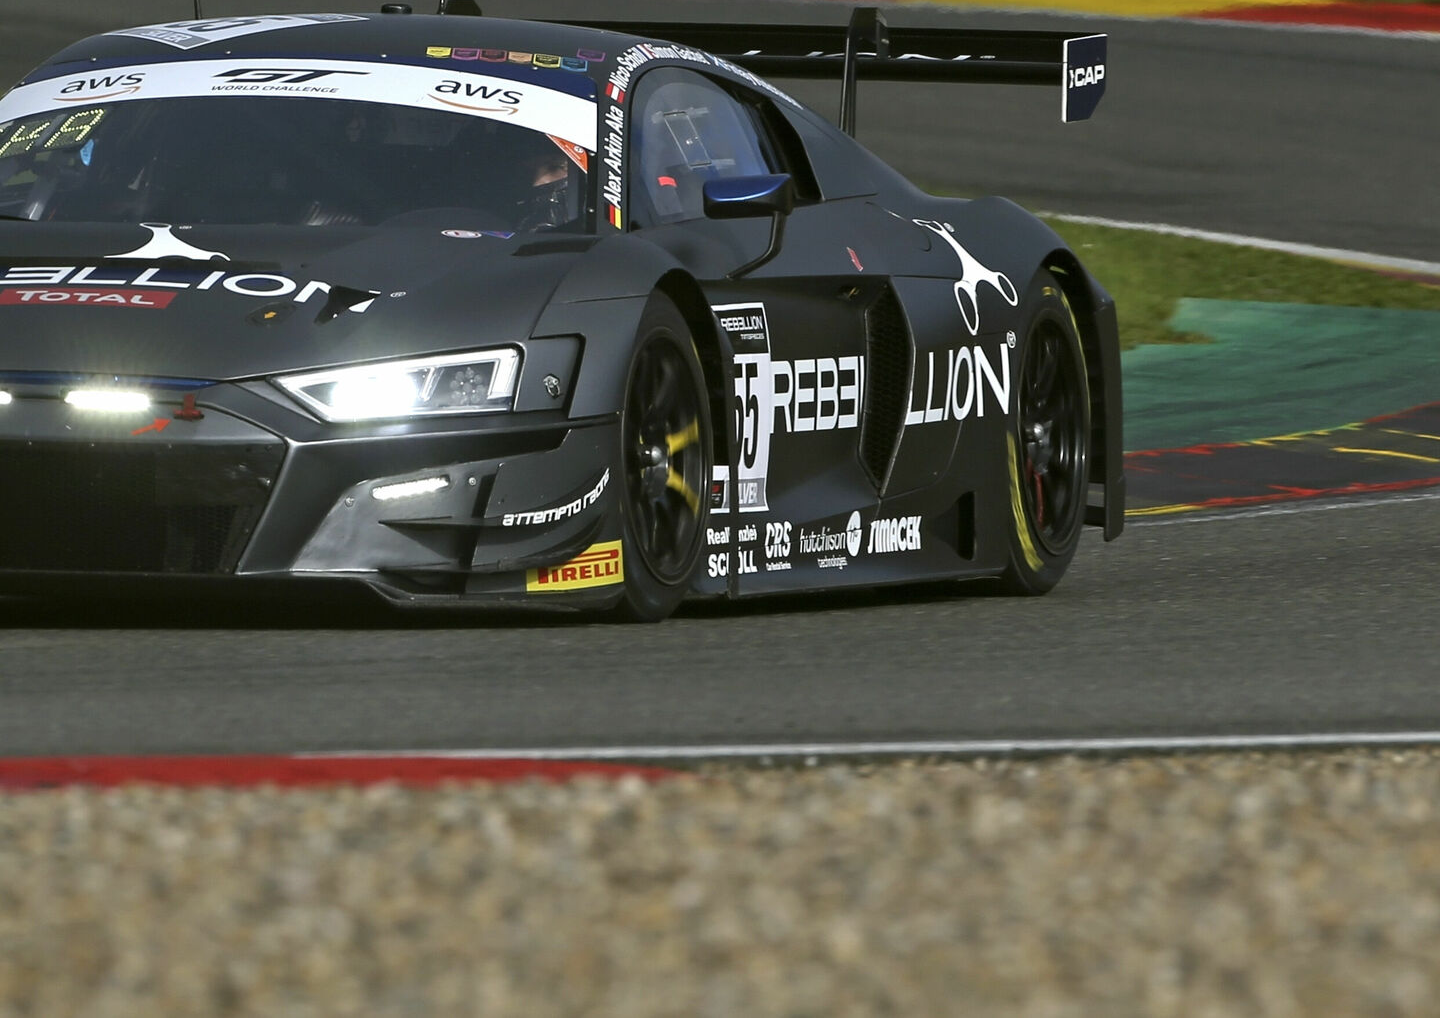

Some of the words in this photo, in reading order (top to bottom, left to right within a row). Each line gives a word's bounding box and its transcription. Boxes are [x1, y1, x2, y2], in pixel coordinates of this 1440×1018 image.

[60, 72, 146, 94] aws
[211, 84, 260, 92] WORLD
[262, 85, 339, 94] CHALLENGE
[212, 68, 371, 84] GT
[609, 65, 631, 93] Nico
[435, 79, 523, 105] aws
[605, 105, 624, 137] Aka
[603, 131, 624, 175] Arkin
[603, 171, 622, 210] Alex
[16, 290, 155, 305] TOTAL
[720, 315, 764, 332] REBELLION
[537, 549, 620, 585] PIRELLI
